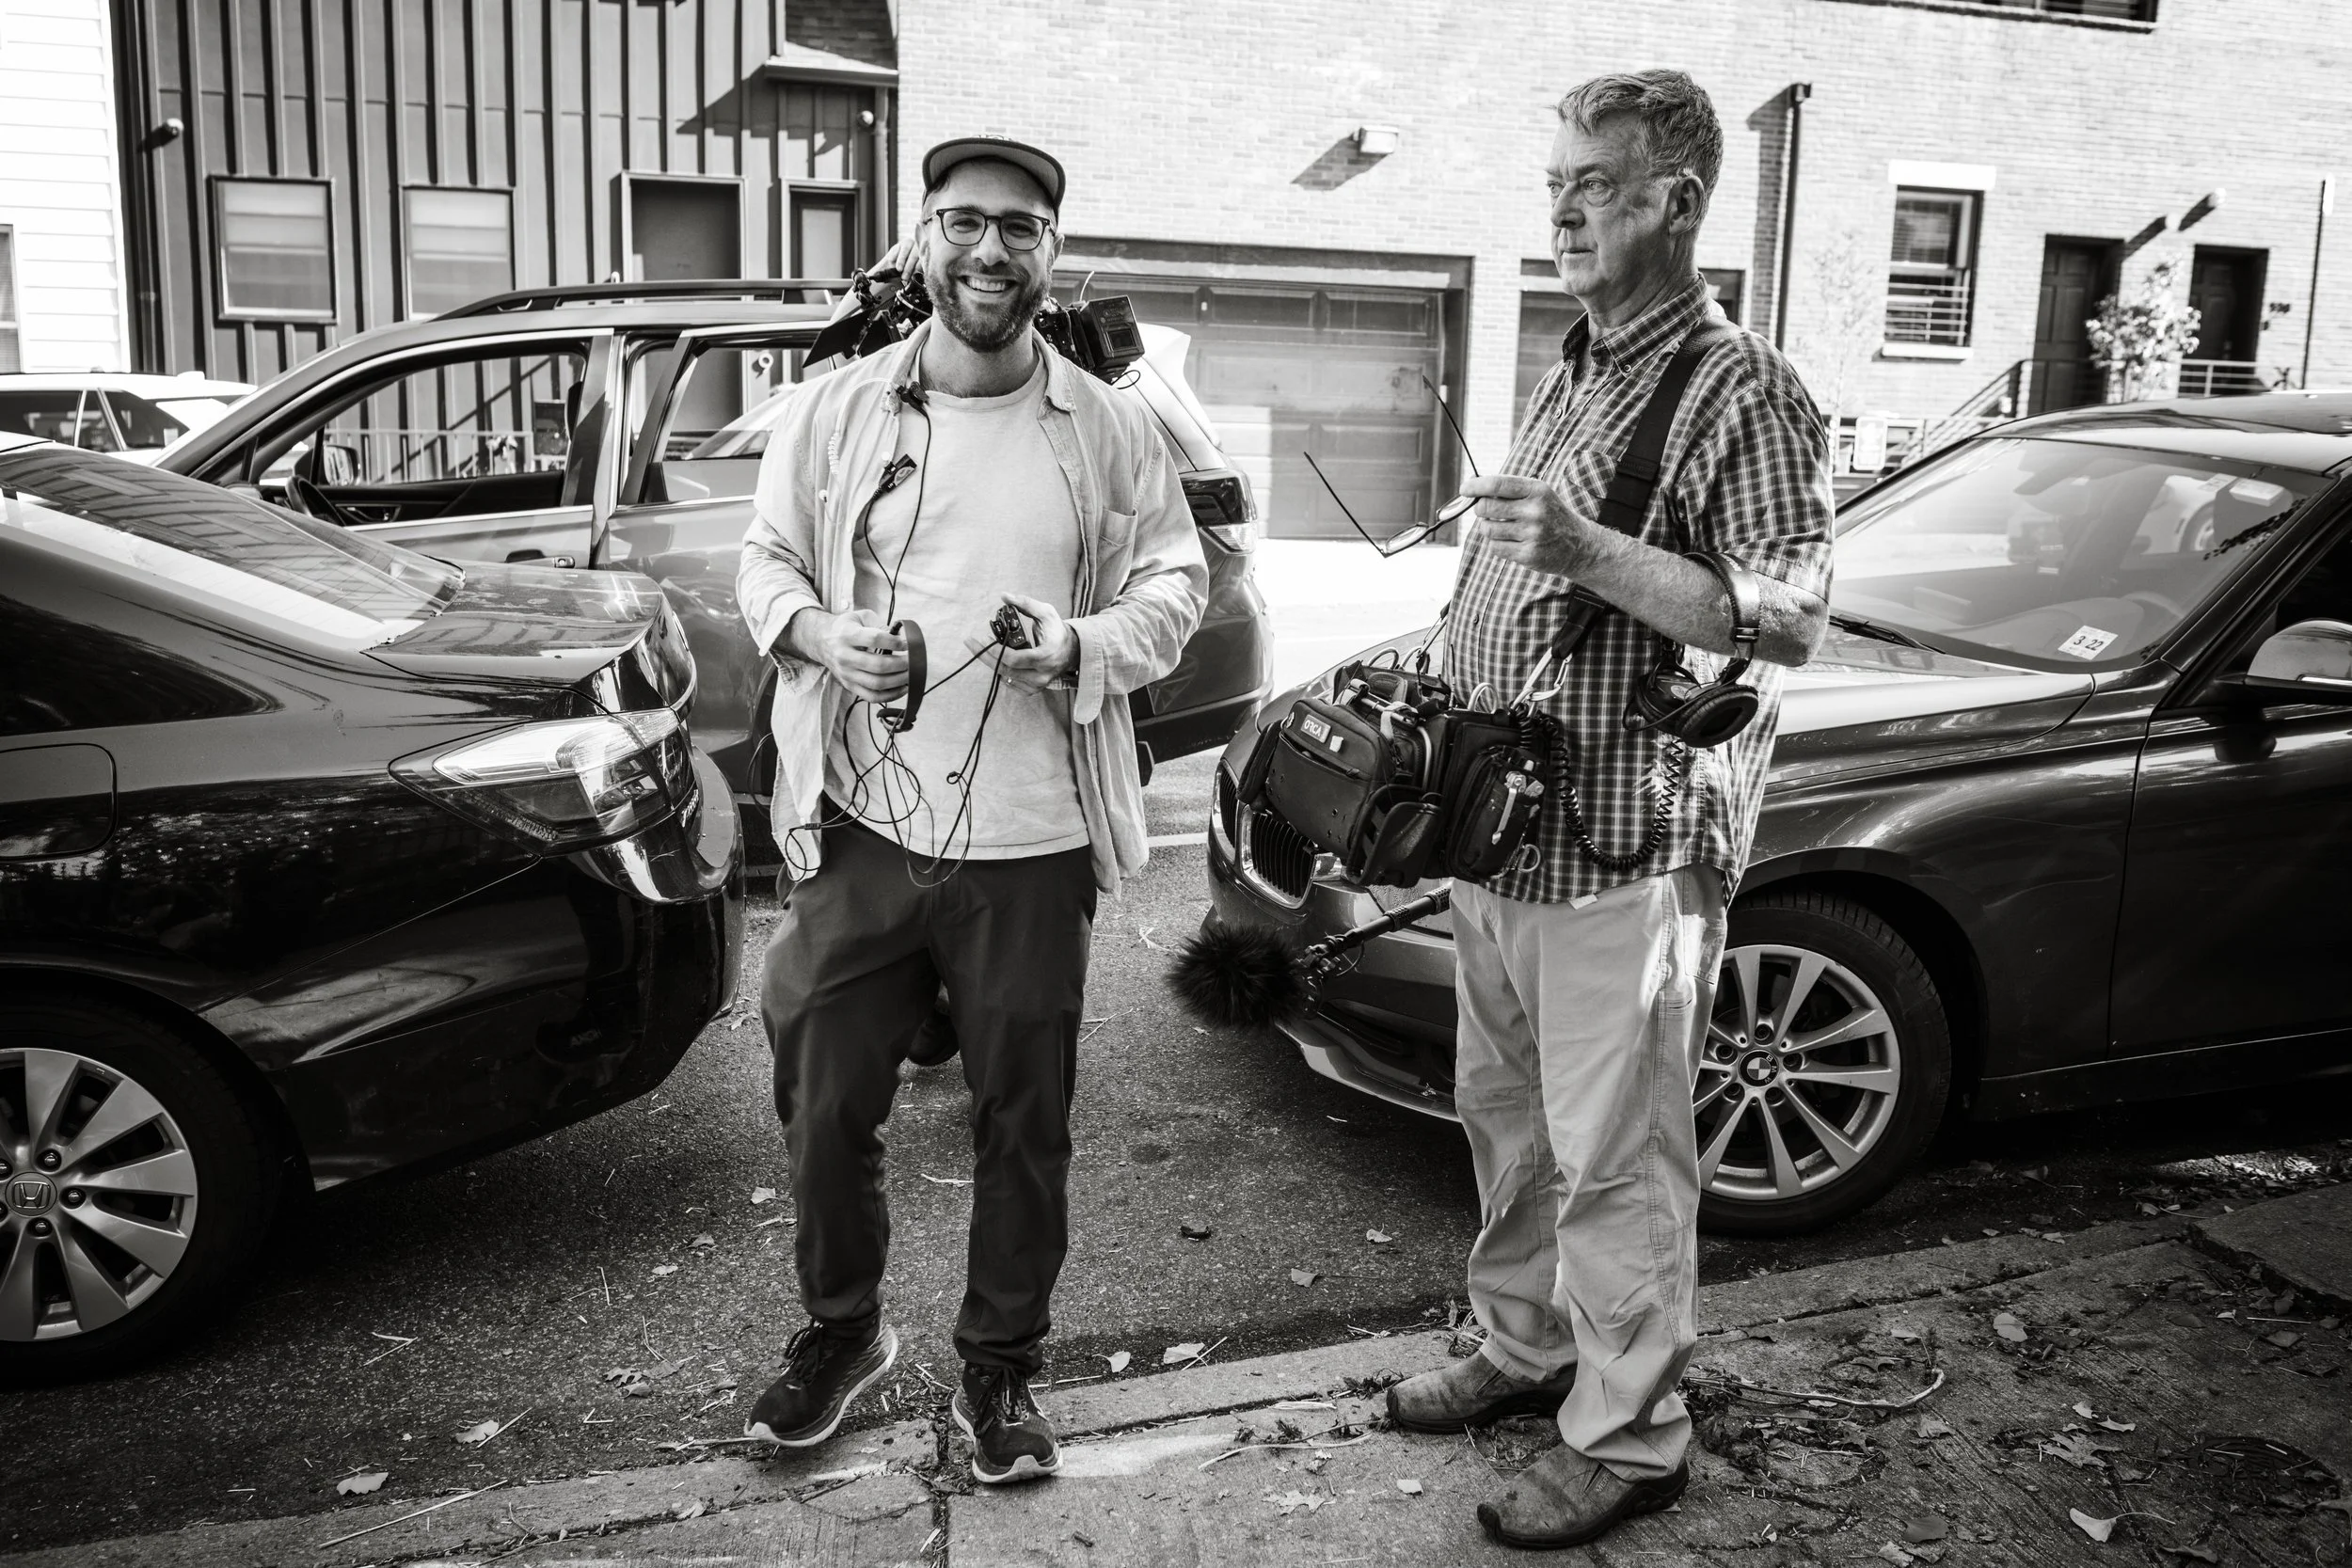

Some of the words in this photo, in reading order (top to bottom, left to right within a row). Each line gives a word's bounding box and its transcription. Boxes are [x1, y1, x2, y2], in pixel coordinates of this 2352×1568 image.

[2073, 635, 2087, 646] 3
[2084, 639, 2105, 652] 22
[1304, 719, 1323, 737] ORCA
